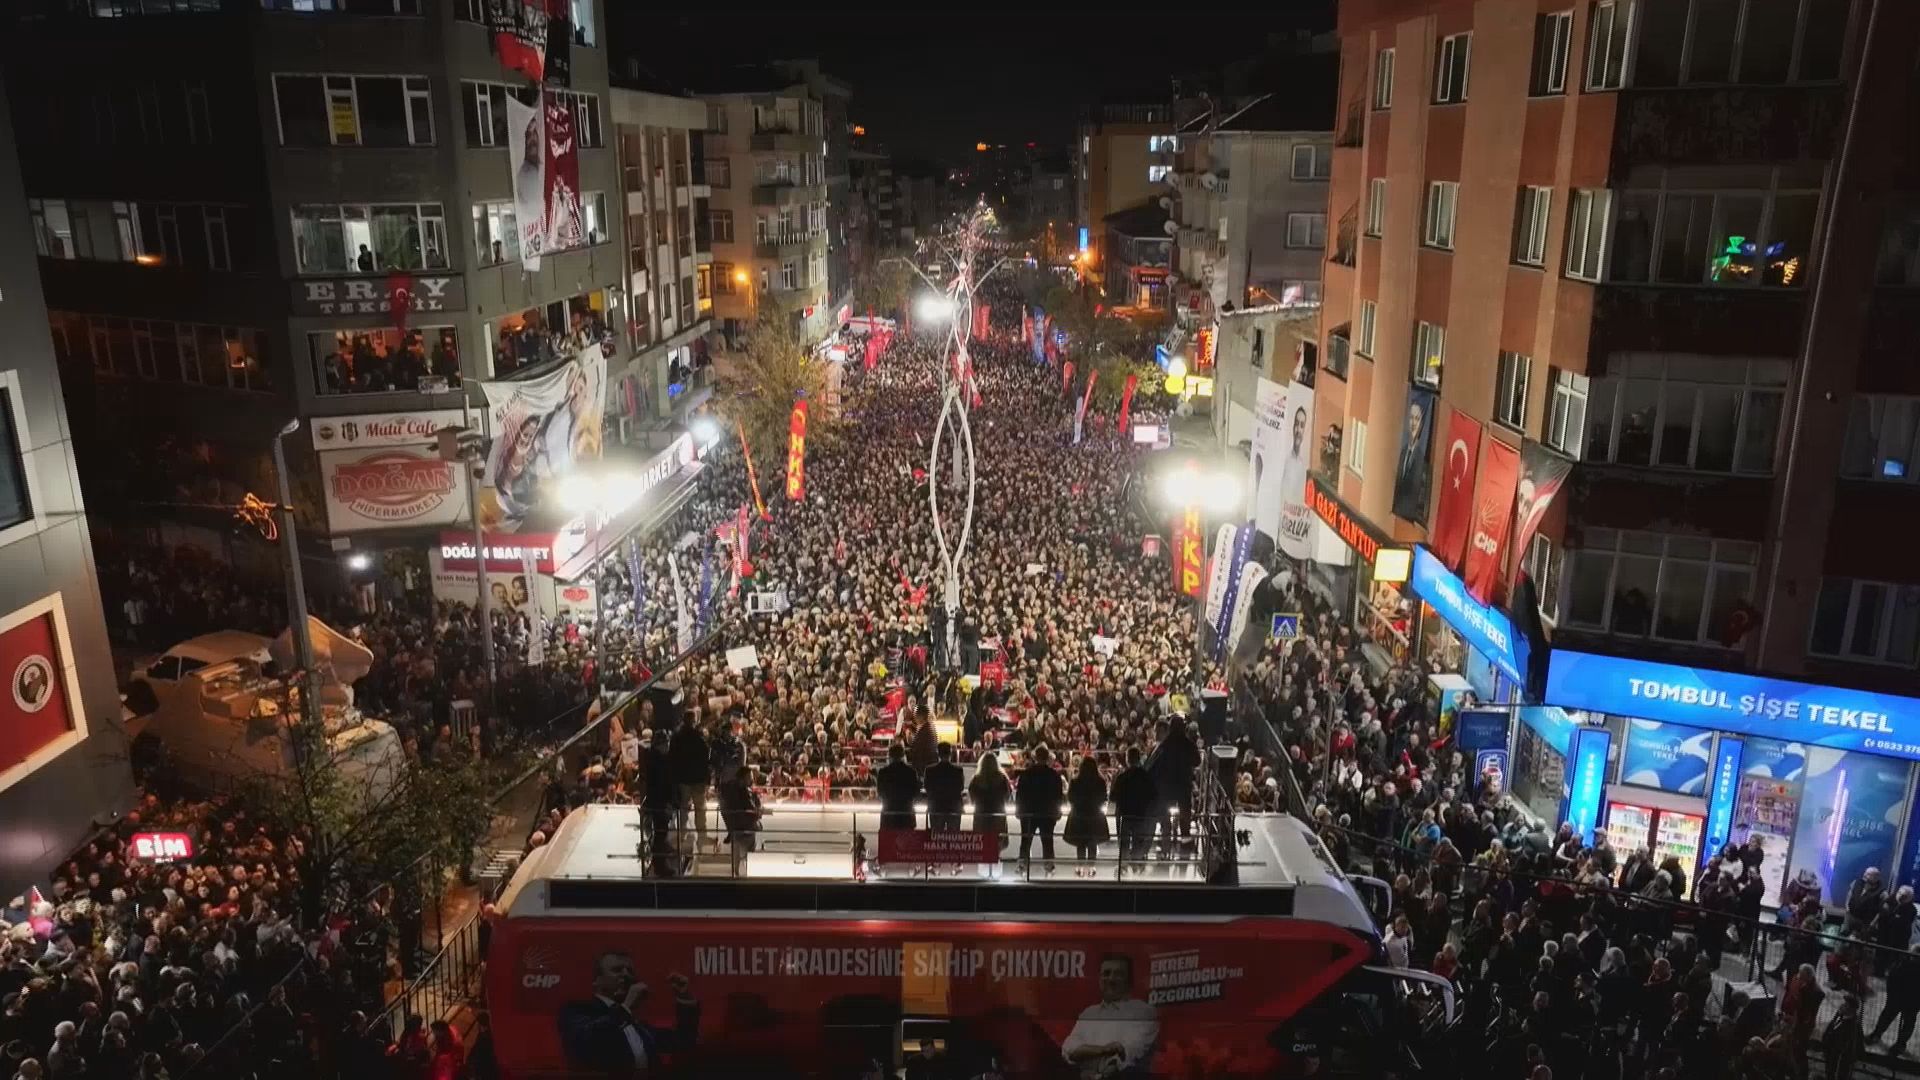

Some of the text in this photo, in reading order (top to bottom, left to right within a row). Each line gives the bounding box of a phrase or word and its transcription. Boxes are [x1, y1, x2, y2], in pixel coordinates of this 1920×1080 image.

[304, 278, 450, 301] ERY
[320, 300, 443, 314] TEKSİL
[333, 462, 456, 502] DOĞAN
[1473, 530, 1498, 556] CHP
[1629, 678, 1894, 734] TOMBUL ŞİŞE TEKEL
[136, 834, 188, 857] BİM
[694, 946, 779, 977] MİLLET
[912, 948, 985, 977] SAHİP
[991, 949, 1086, 982] ÇIKIYOR
[522, 974, 561, 989] CHP
